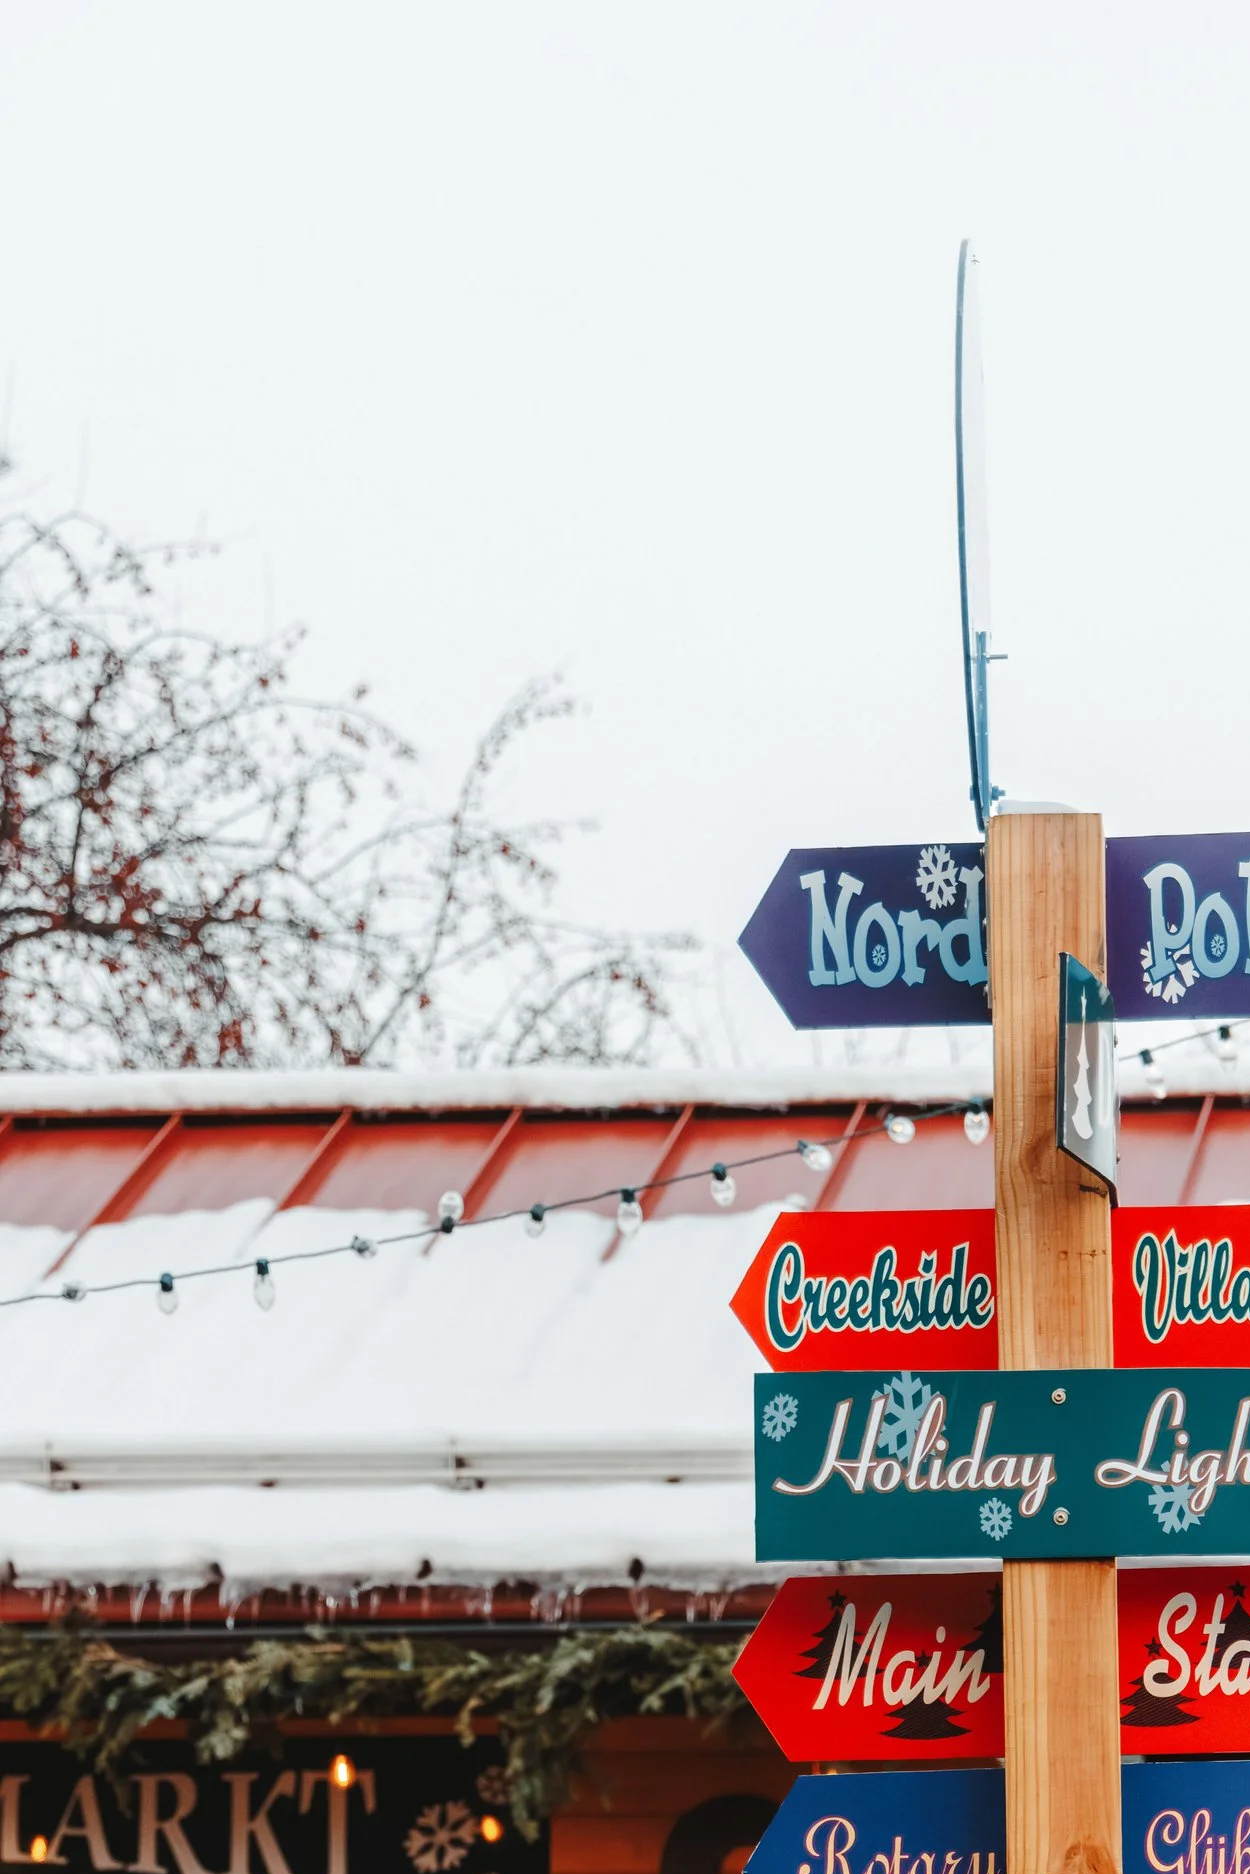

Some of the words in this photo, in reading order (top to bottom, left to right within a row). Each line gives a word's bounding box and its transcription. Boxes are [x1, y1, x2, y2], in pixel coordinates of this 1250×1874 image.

[800, 865, 989, 988] Nord
[765, 1242, 995, 1352] Creekside
[773, 1393, 1056, 1518] Holiday
[812, 1601, 991, 1710] Main
